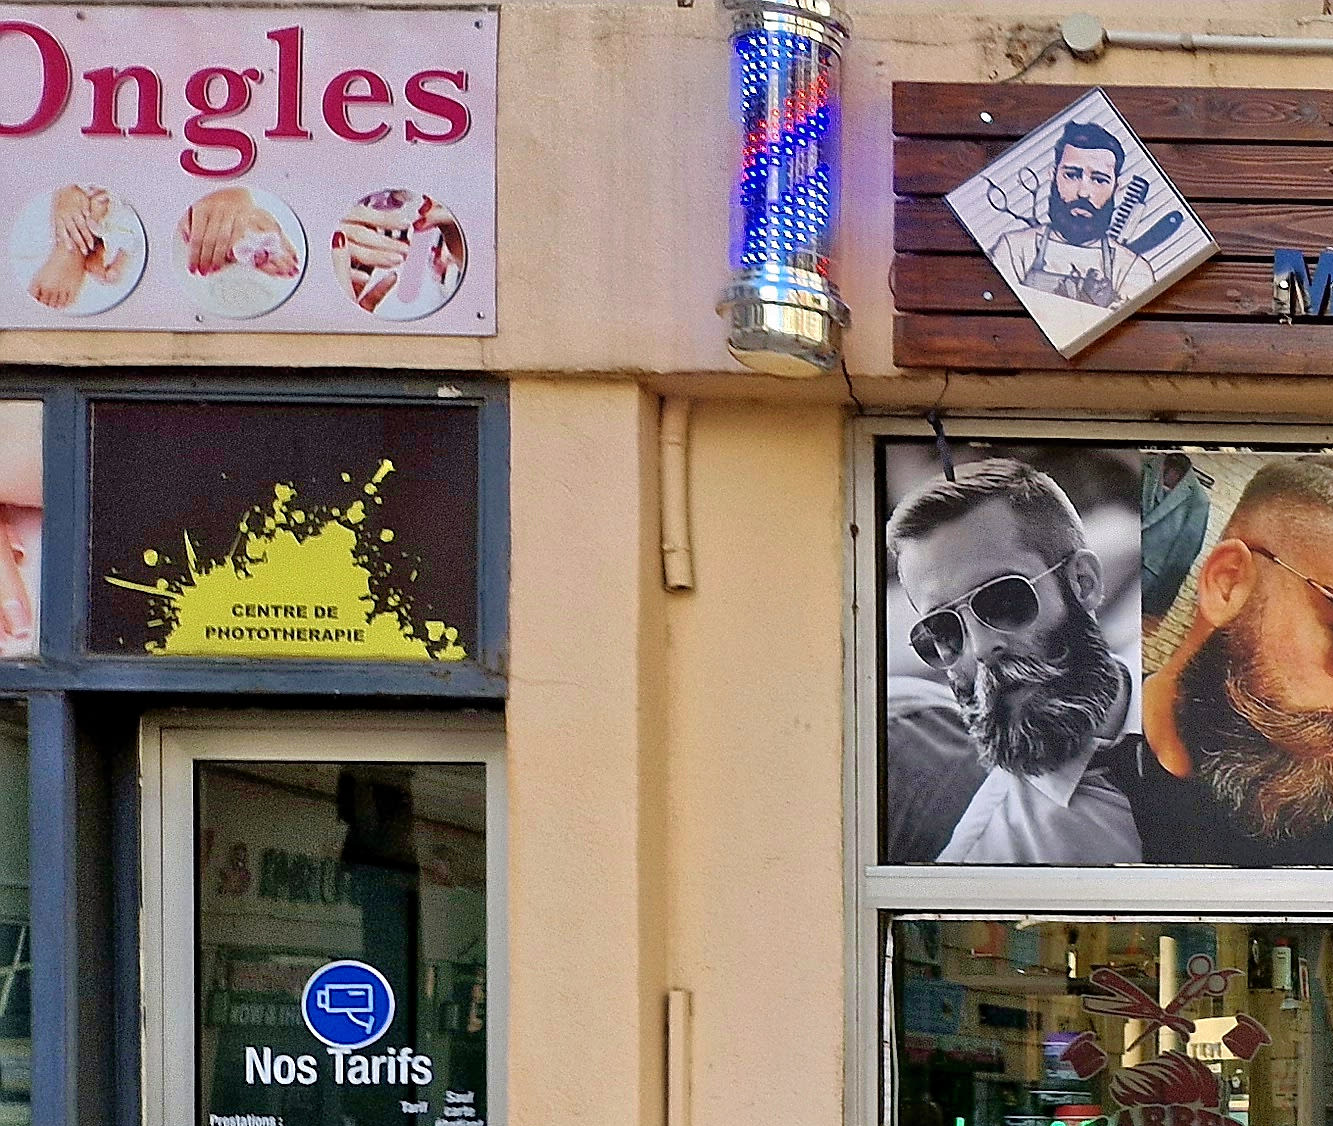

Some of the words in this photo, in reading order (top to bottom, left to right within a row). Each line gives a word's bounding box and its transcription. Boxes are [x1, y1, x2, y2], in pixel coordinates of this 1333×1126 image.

[0, 21, 471, 177] Ongles
[231, 603, 299, 621] CENTRE
[308, 603, 339, 620] DE
[205, 626, 366, 644] PHOTOTHERAPIE
[245, 1046, 318, 1085] Nos
[327, 1047, 433, 1085] Tarifs
